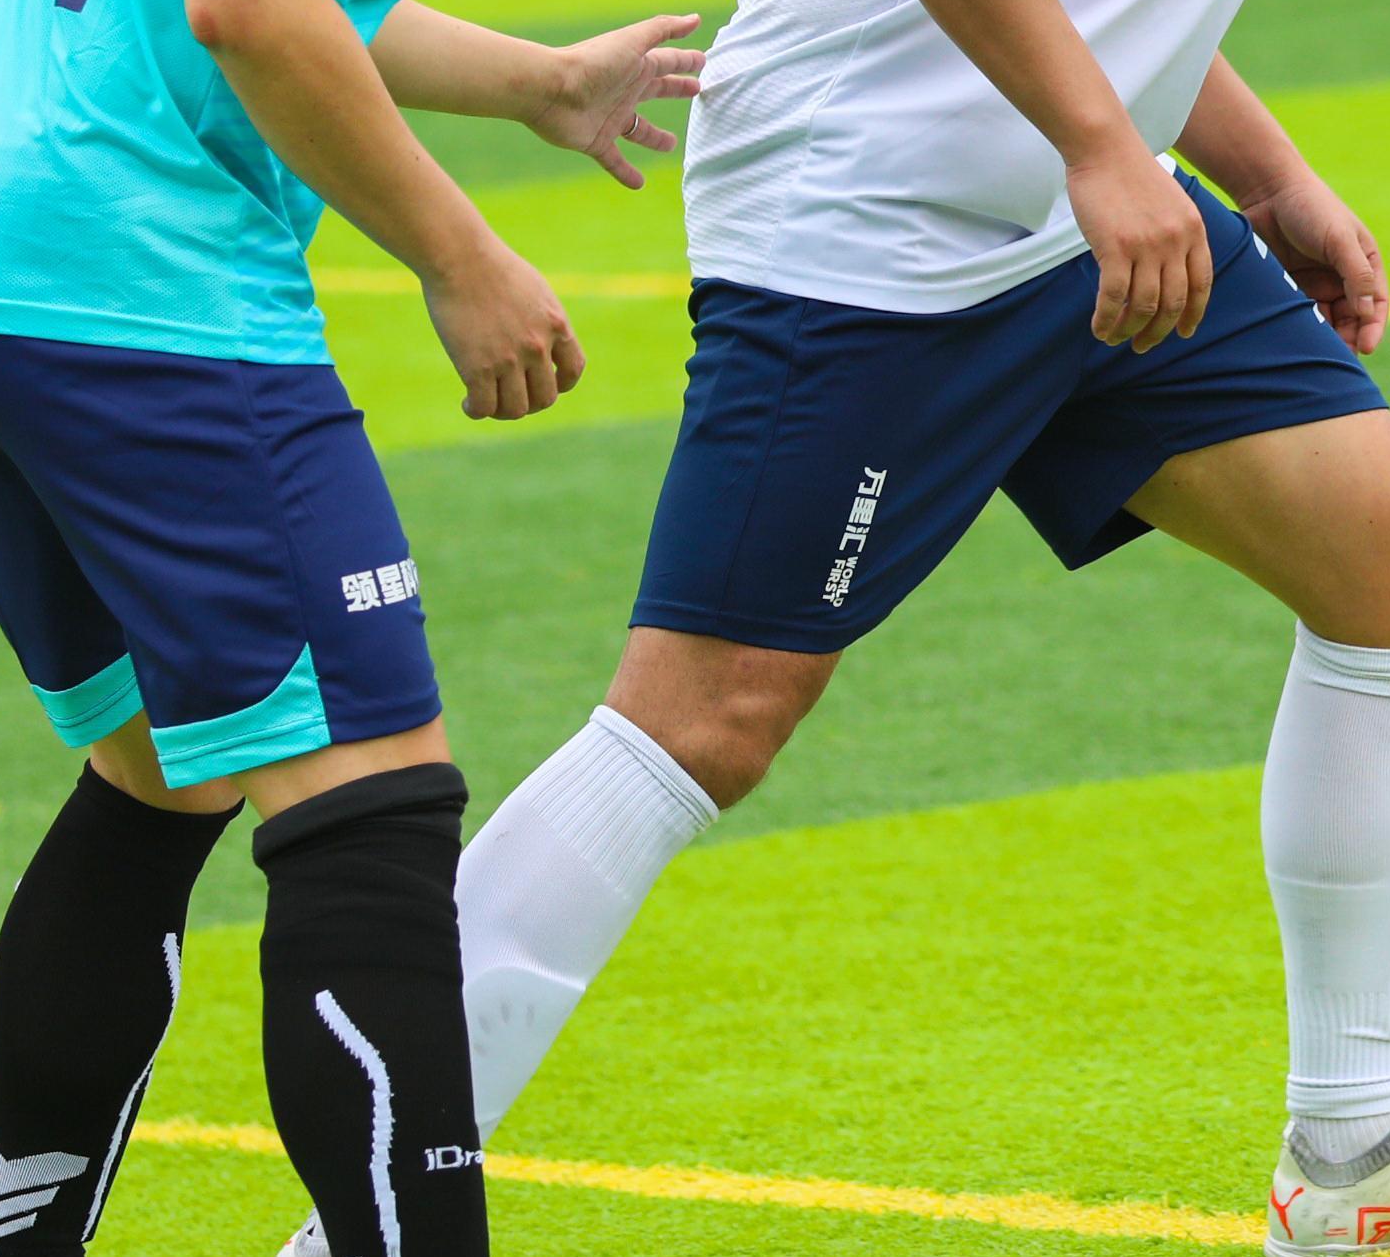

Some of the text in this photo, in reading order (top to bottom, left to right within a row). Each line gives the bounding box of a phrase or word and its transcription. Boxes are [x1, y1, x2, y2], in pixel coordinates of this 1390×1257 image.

[838, 466, 888, 553] 万里汇
[822, 558, 847, 603] FIRST
[832, 556, 859, 608] WORLD
